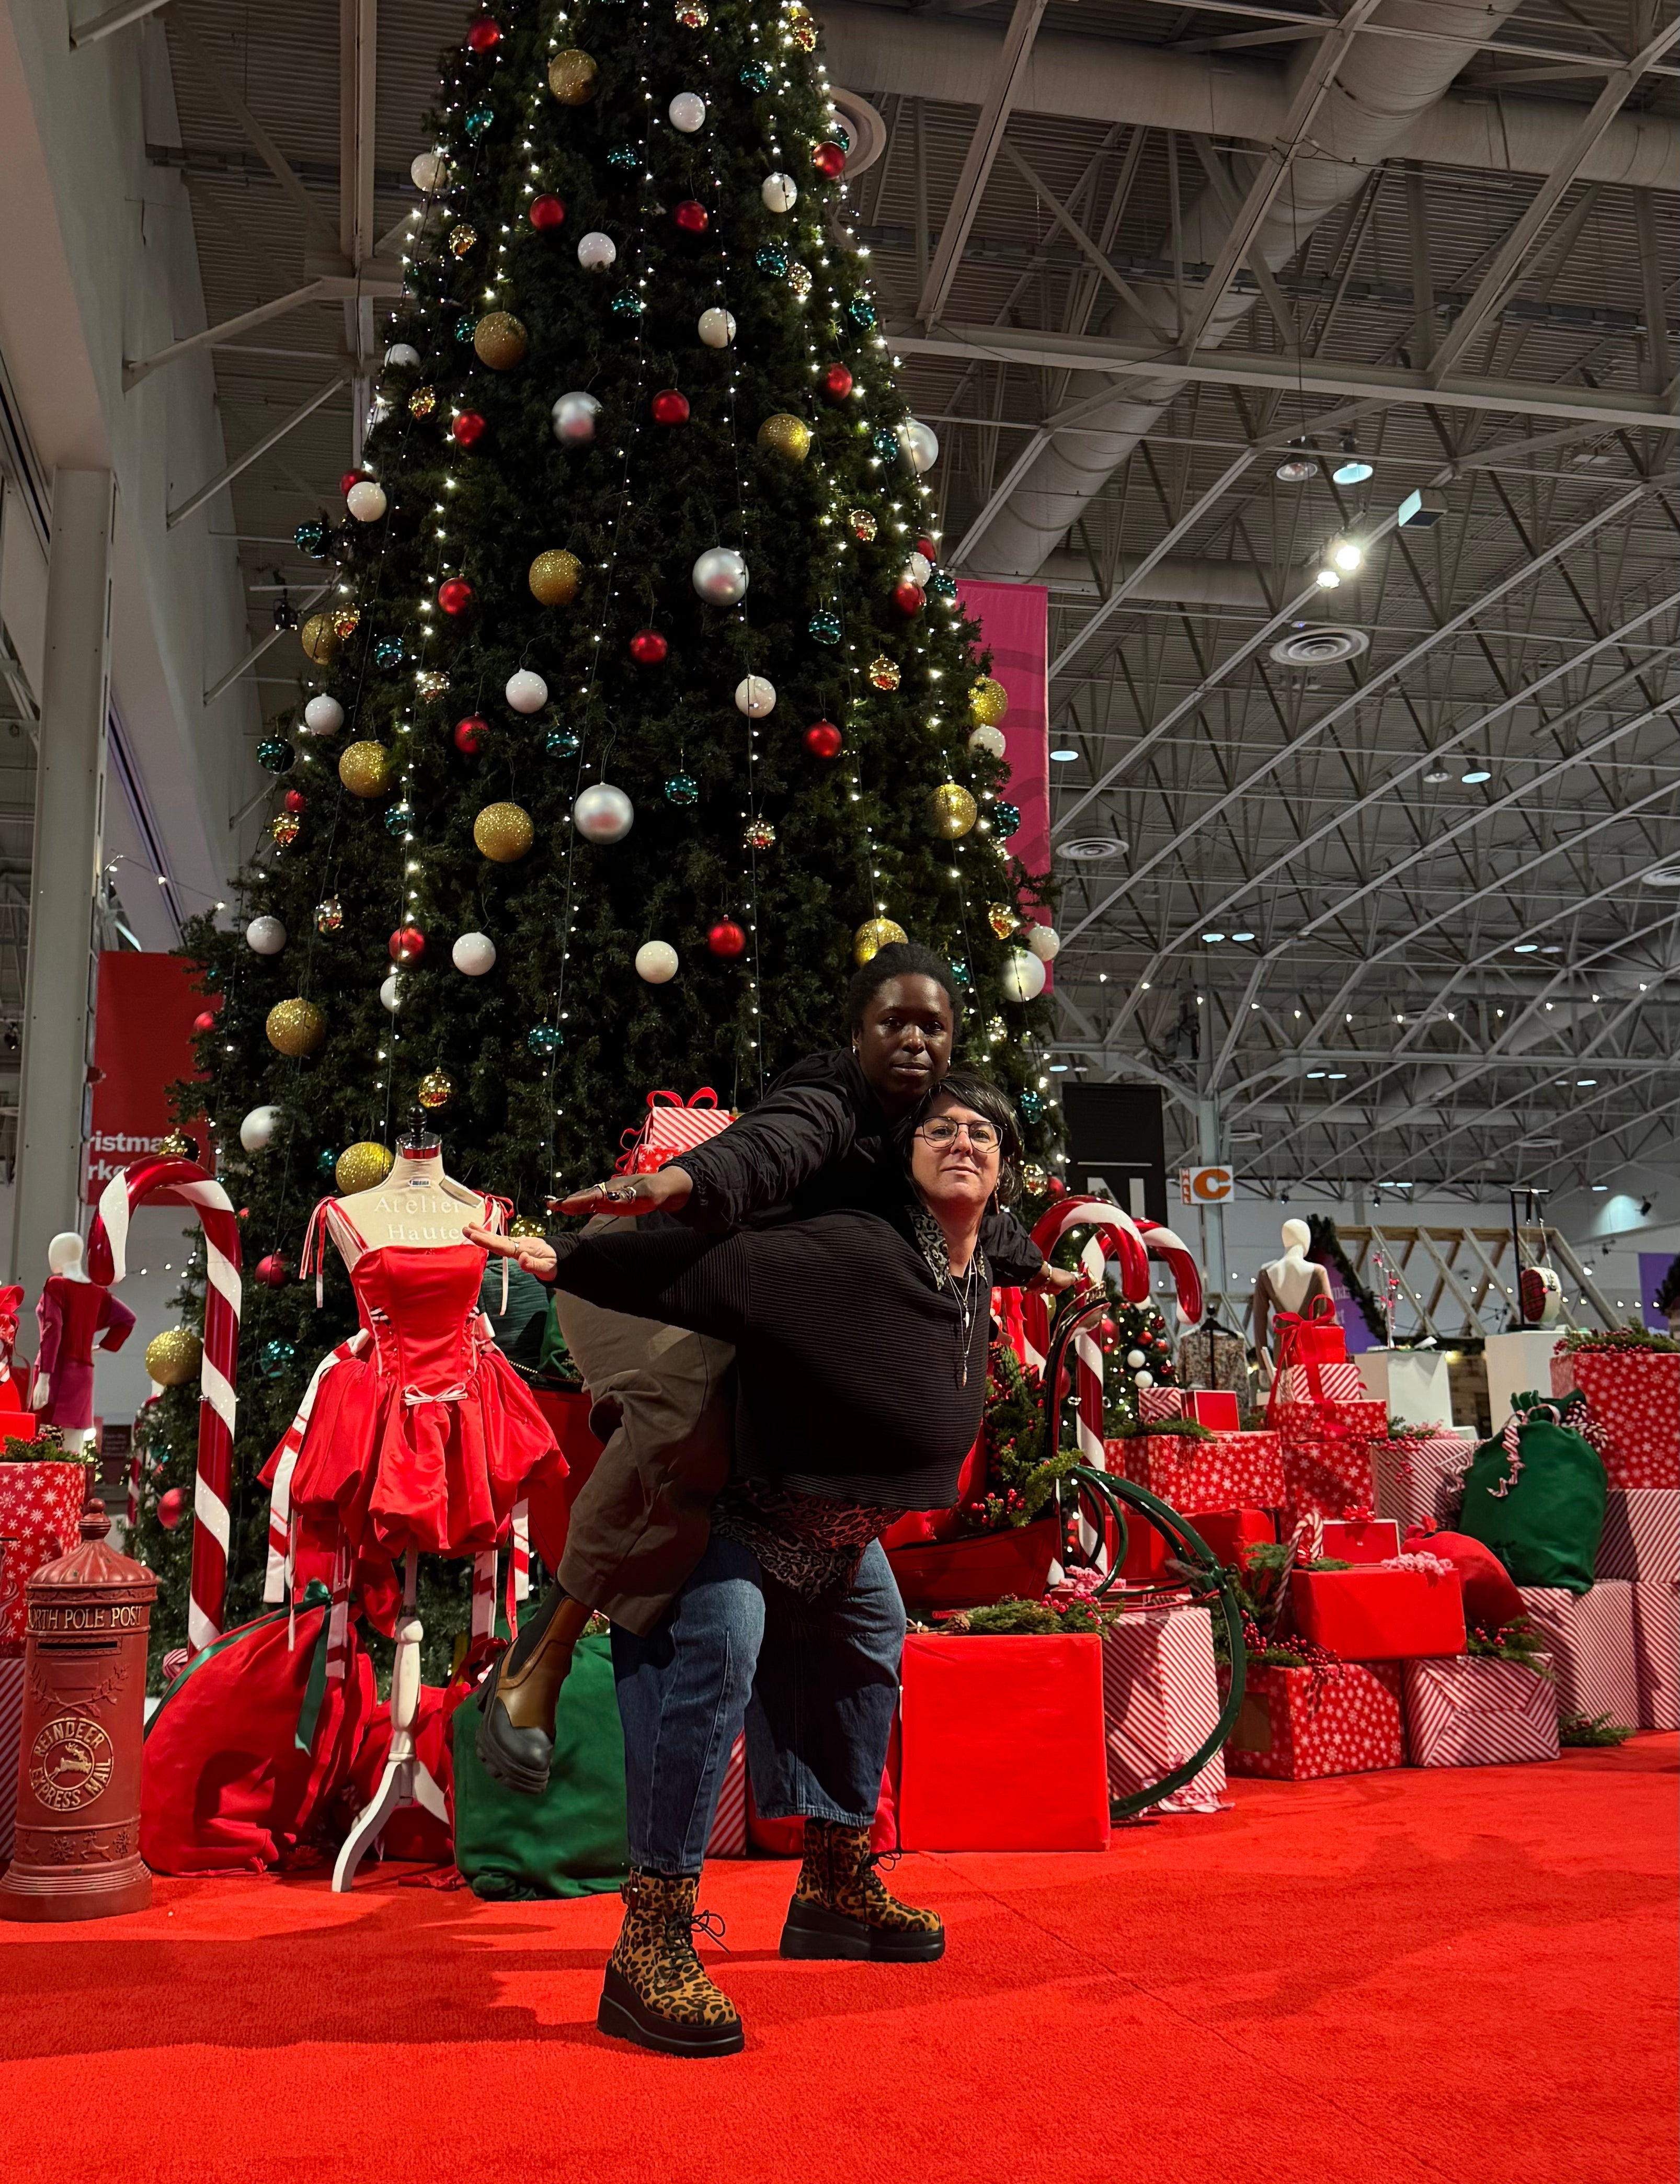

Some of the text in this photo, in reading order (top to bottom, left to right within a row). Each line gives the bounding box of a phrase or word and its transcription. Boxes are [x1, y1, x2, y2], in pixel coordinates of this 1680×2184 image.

[87, 1130, 164, 1153] ristma
[1193, 1168, 1231, 1200] C
[374, 1195, 460, 1214] Atelier
[387, 1224, 460, 1241] Haute
[64, 1608, 105, 1629] POLE
[110, 1606, 143, 1627] POST
[33, 1722, 105, 1758] REINDEER
[31, 1758, 111, 1808] EXPRESS MAIL
